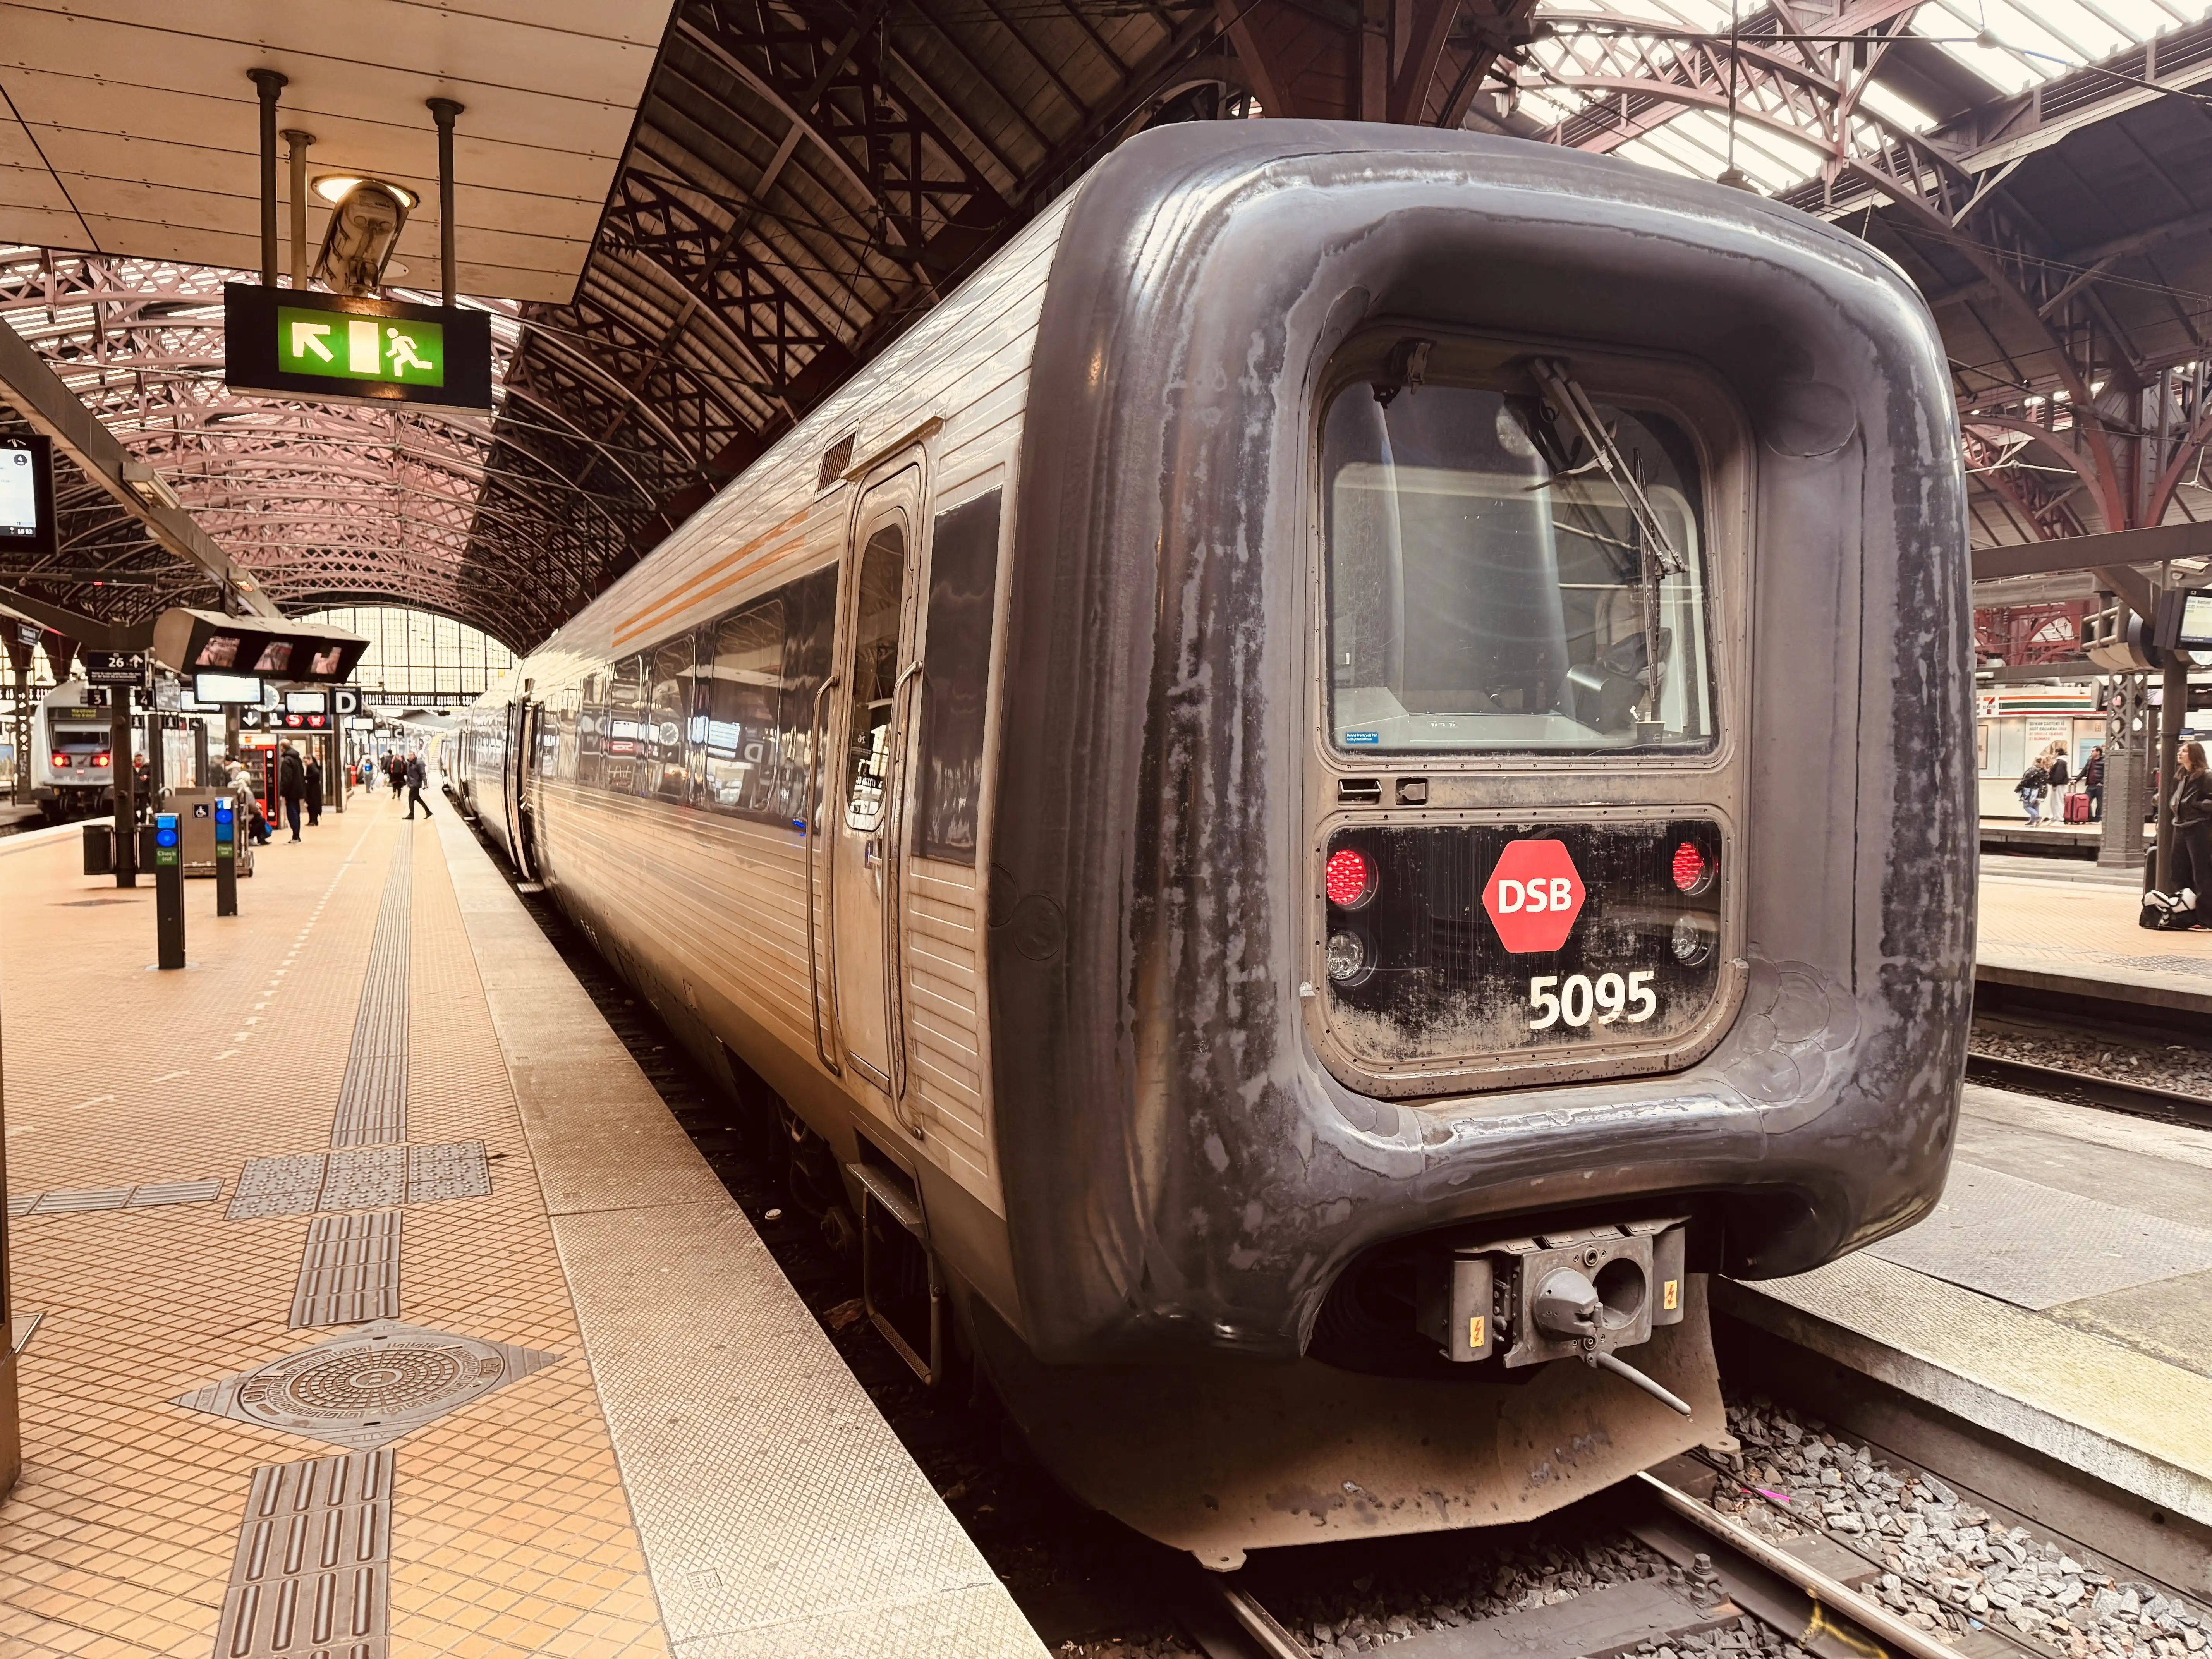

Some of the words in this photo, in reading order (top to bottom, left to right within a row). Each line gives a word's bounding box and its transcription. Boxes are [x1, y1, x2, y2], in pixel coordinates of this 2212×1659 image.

[108, 657, 124, 668] 26
[94, 694, 101, 704] 3
[140, 696, 148, 705] 4
[336, 692, 356, 714] D
[394, 728, 403, 738] C
[1498, 878, 1572, 914] DSB
[1530, 970, 1657, 1029] 5095
[352, 1432, 386, 1441] CITY
